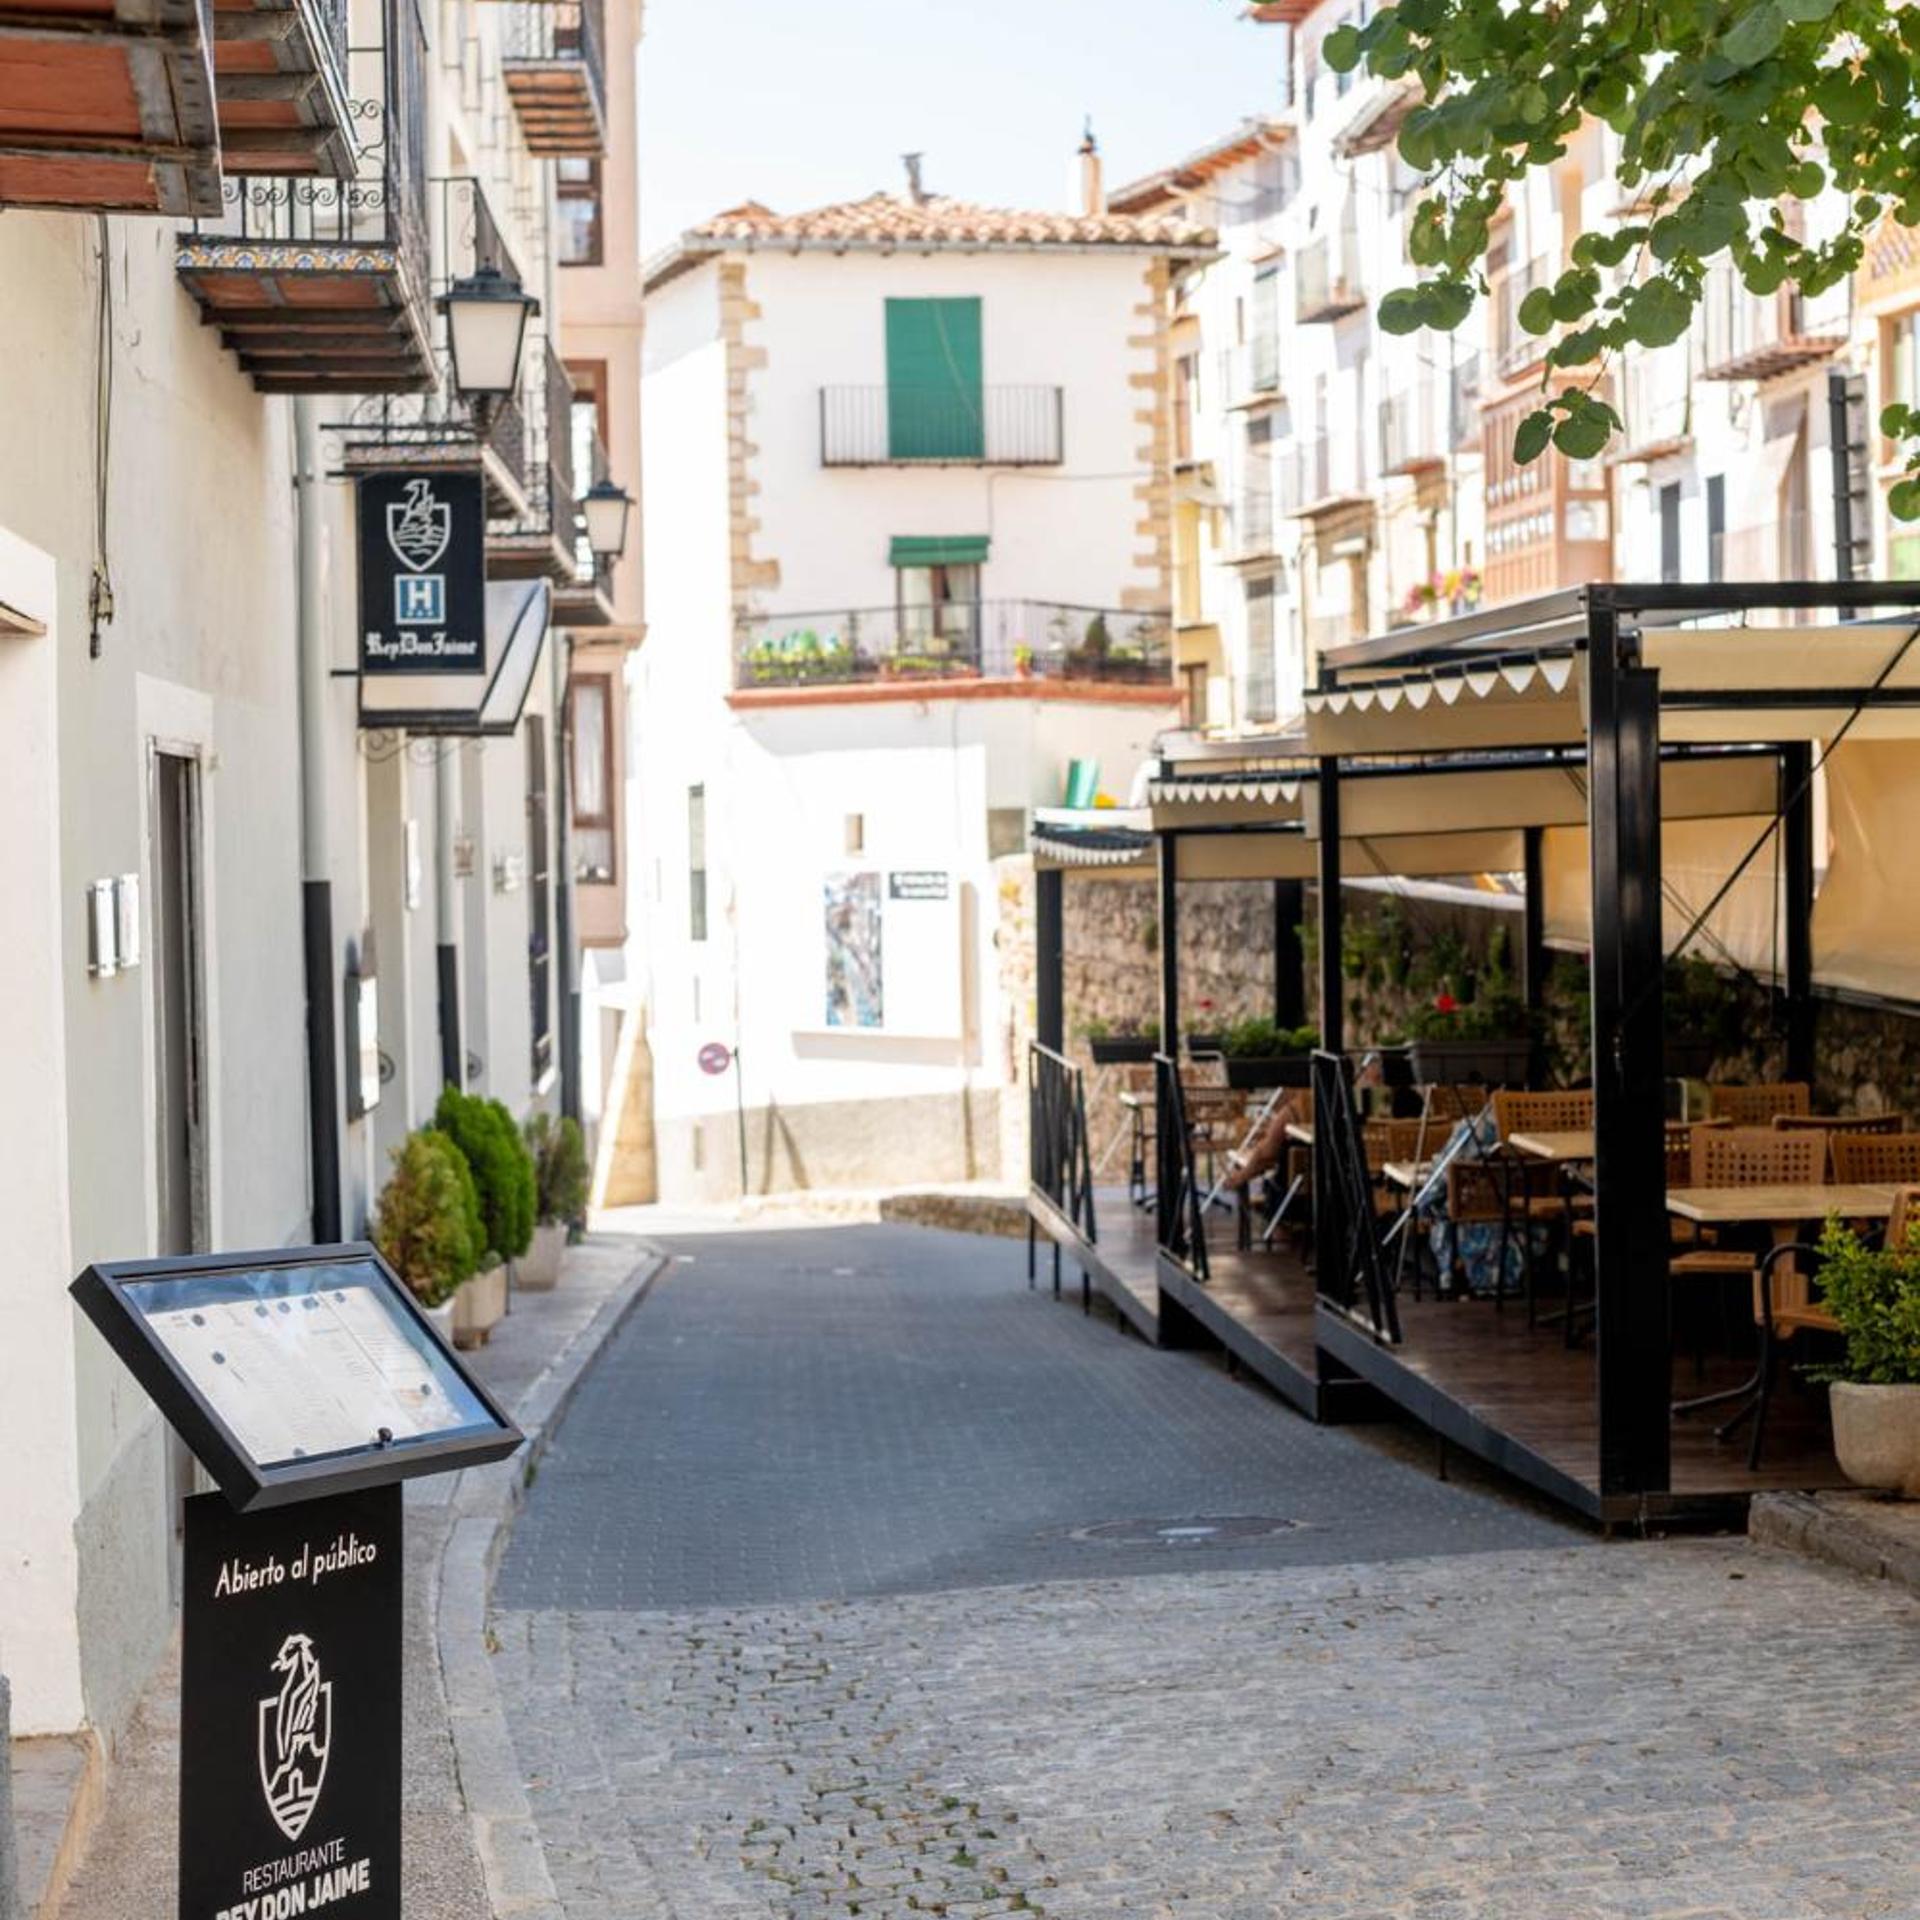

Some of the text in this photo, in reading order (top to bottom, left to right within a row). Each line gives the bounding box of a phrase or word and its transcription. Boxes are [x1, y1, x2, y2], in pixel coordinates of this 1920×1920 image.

[408, 581, 432, 609] H
[214, 1533, 376, 1598] Abierto al público
[242, 1837, 346, 1895] RESTAURANTE
[261, 1881, 305, 1920] DON
[308, 1857, 370, 1909] JAIME
